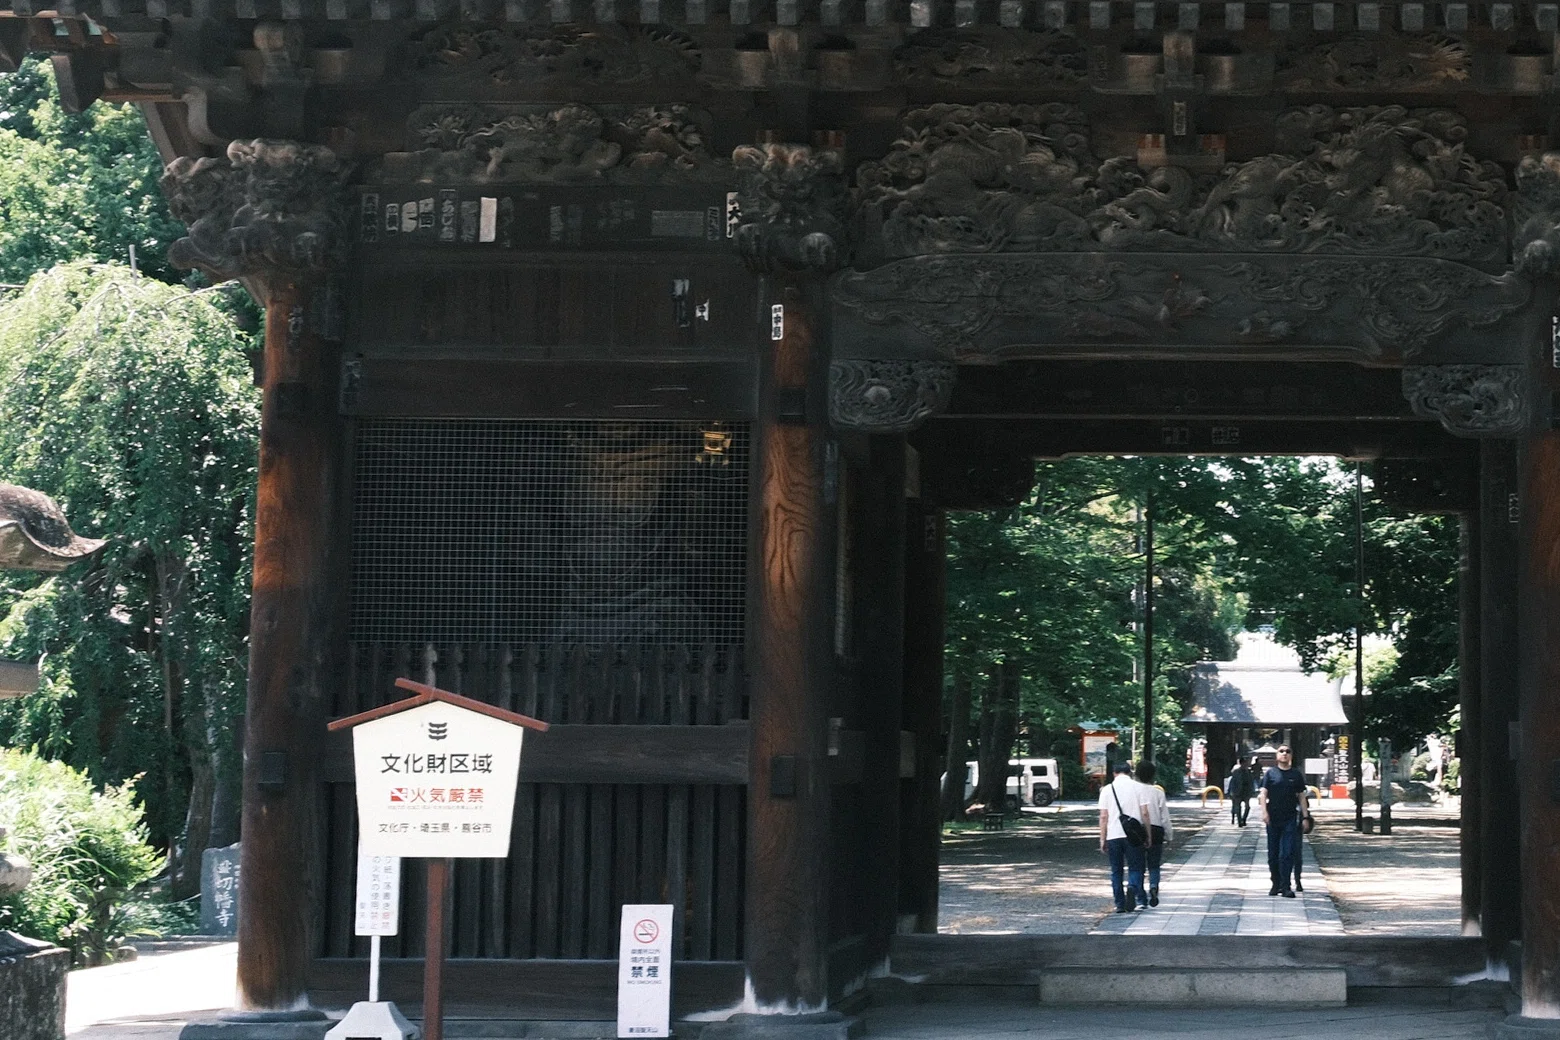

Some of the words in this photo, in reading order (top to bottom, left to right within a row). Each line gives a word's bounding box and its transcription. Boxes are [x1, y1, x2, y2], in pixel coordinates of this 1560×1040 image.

[381, 753, 493, 774] 文化財区域
[410, 788, 484, 803] 火気厳禁
[631, 966, 659, 978] 禁煙
